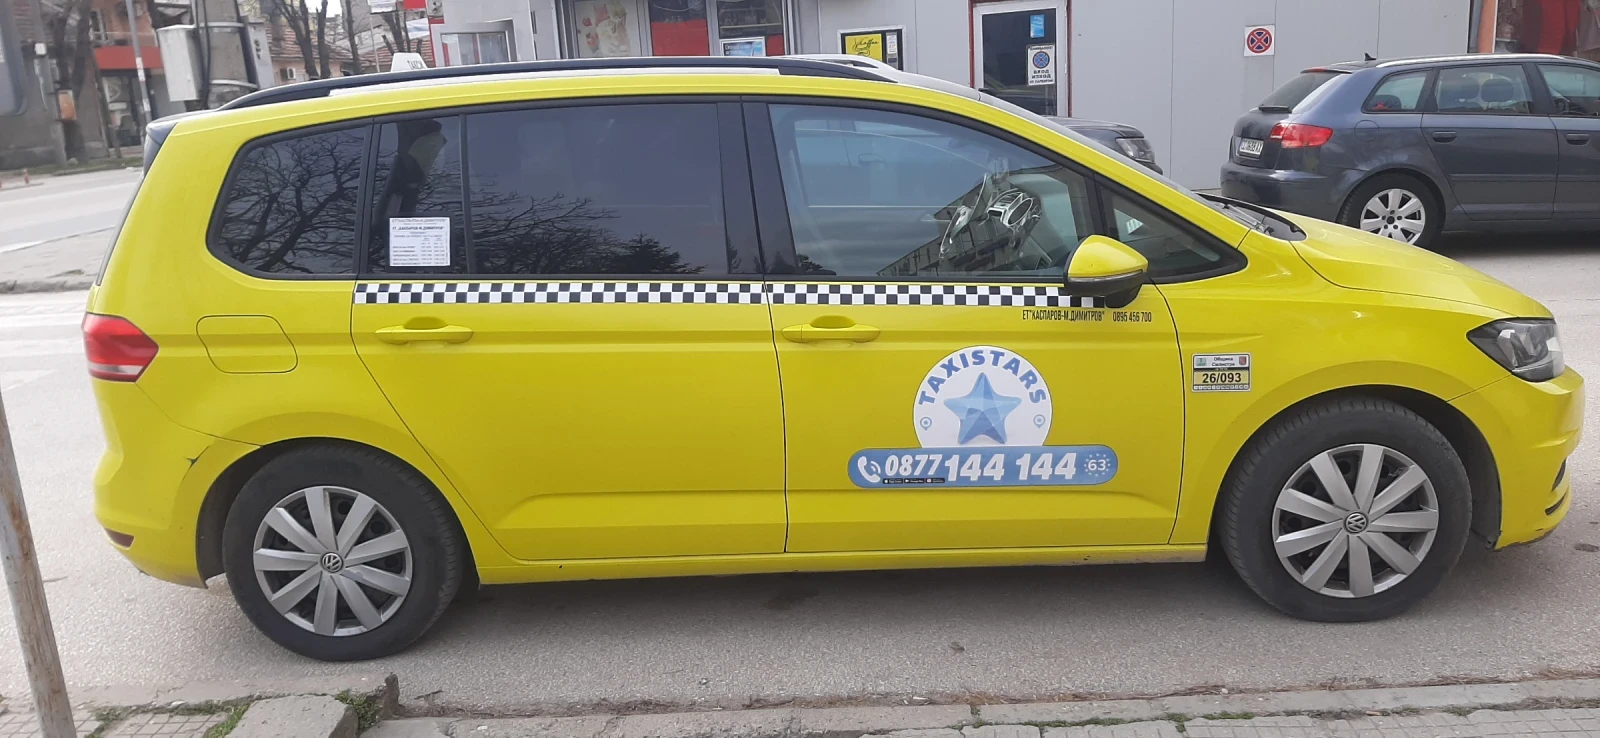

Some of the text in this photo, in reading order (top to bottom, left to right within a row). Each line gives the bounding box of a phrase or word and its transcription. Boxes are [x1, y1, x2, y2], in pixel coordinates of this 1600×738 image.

[1113, 311, 1128, 322] 0895
[1129, 311, 1140, 322] 456
[1141, 311, 1152, 323] 700
[918, 349, 1046, 405] TAXISTARS
[1202, 372, 1241, 383] 26/093
[885, 453, 1106, 481] 0877 144 144 63
